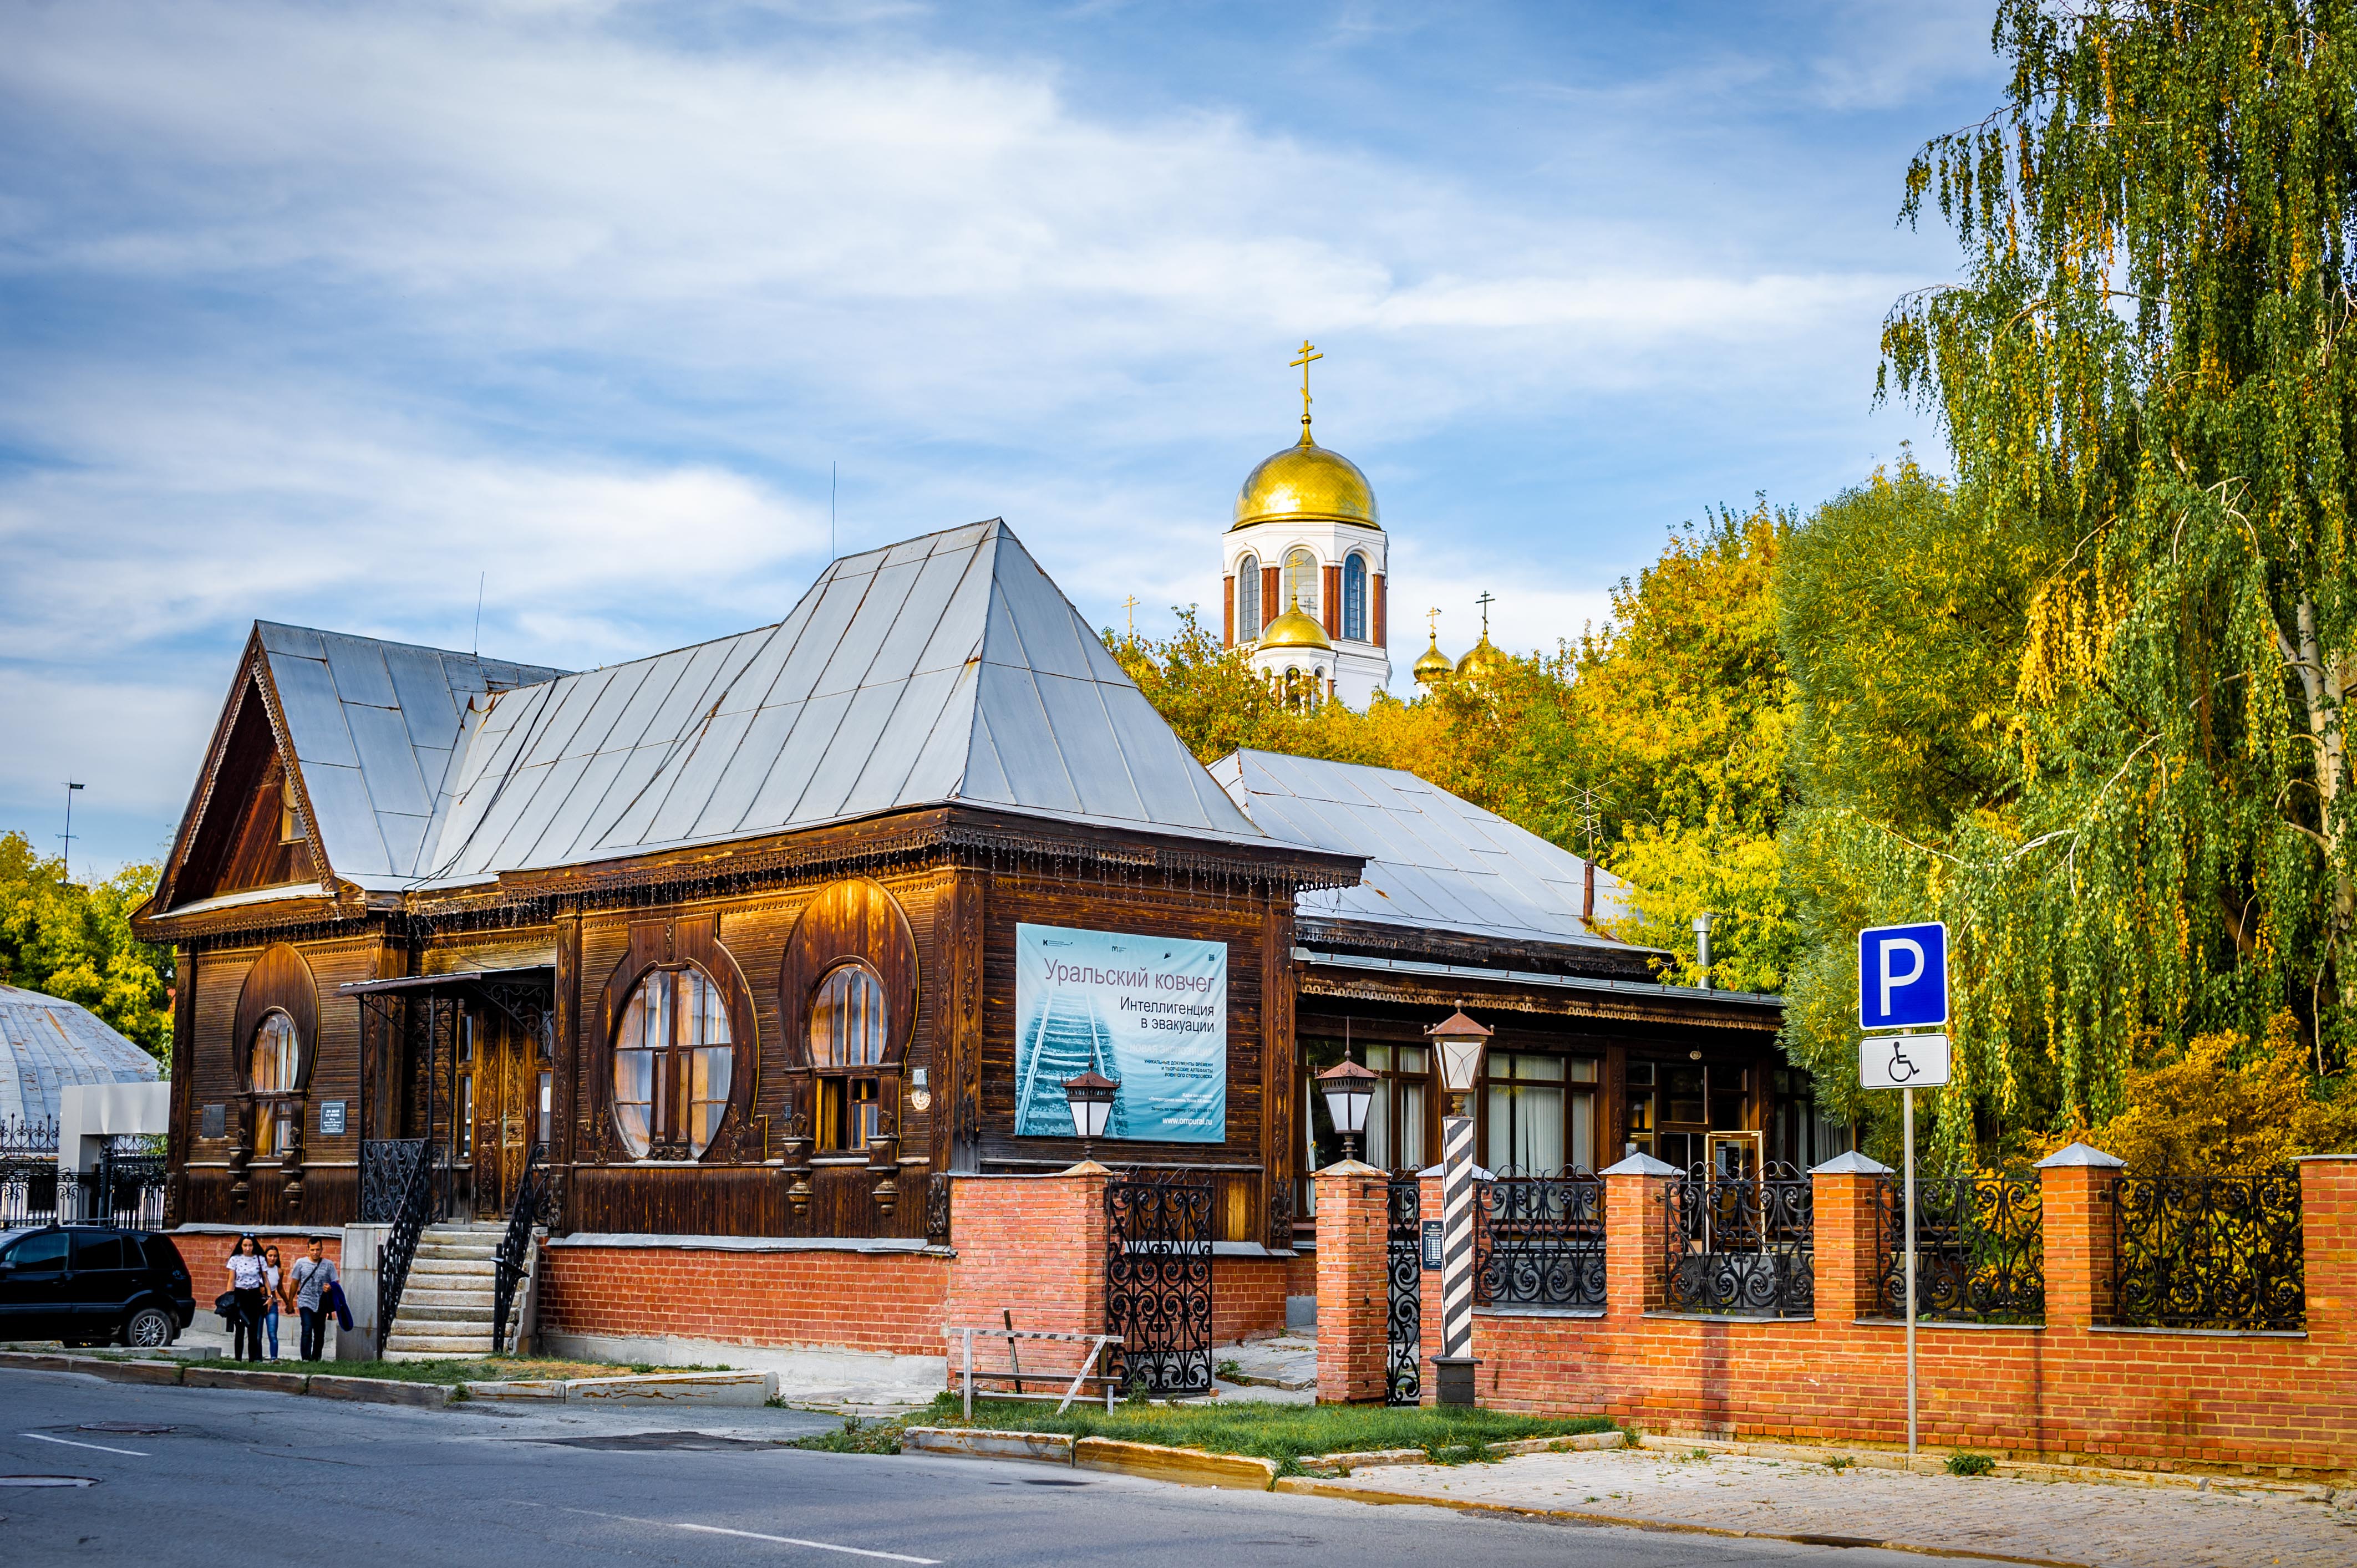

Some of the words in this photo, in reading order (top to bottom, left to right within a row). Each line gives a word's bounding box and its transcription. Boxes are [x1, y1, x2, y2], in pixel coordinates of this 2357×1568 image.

[1044, 958, 1148, 989] Уральский
[1155, 973, 1215, 992] ковчег
[1879, 938, 1924, 1016] P
[1120, 996, 1214, 1018] Интеллигенция
[1141, 1017, 1147, 1029] в
[1151, 1019, 1214, 1035] эвакуации
[1129, 1043, 1158, 1053] НОВАЯ
[1161, 1045, 1213, 1056] ЭКСПОЗИЦИЯ
[1162, 1117, 1212, 1126] www.ompural.ru
